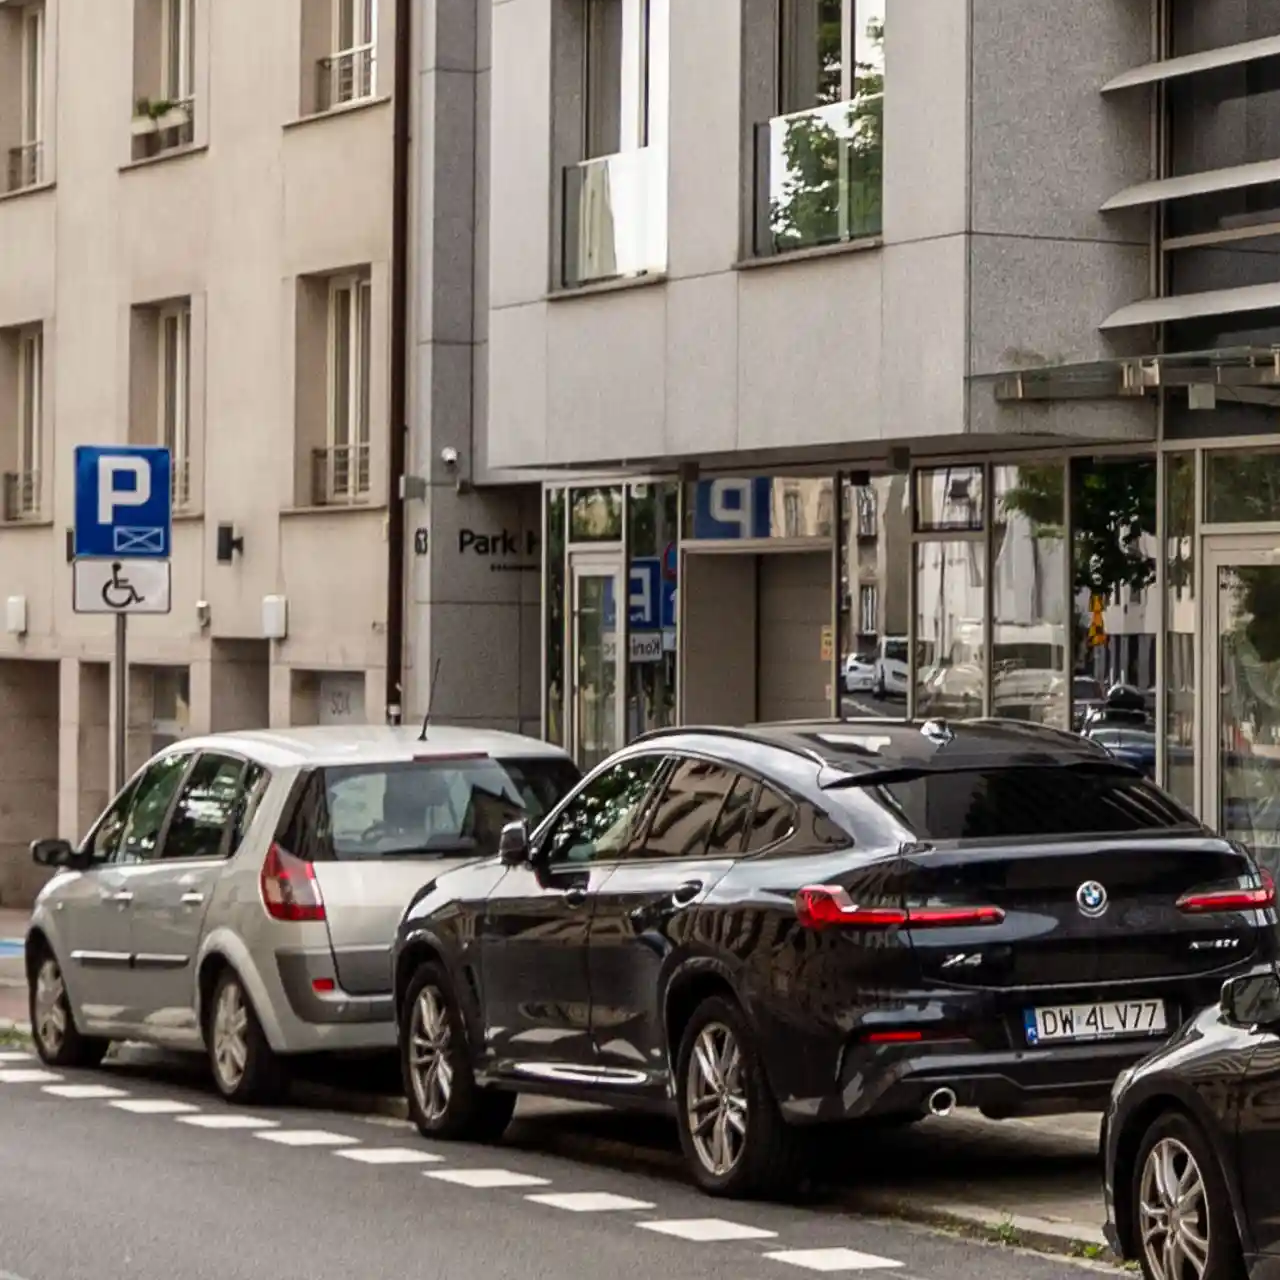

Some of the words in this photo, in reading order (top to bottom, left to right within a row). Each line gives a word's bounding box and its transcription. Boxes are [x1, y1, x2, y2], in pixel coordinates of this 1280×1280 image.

[98, 456, 151, 525] P
[459, 528, 517, 555] Park
[1042, 1009, 1075, 1035] DW
[1086, 1003, 1158, 1031] 4LV77
